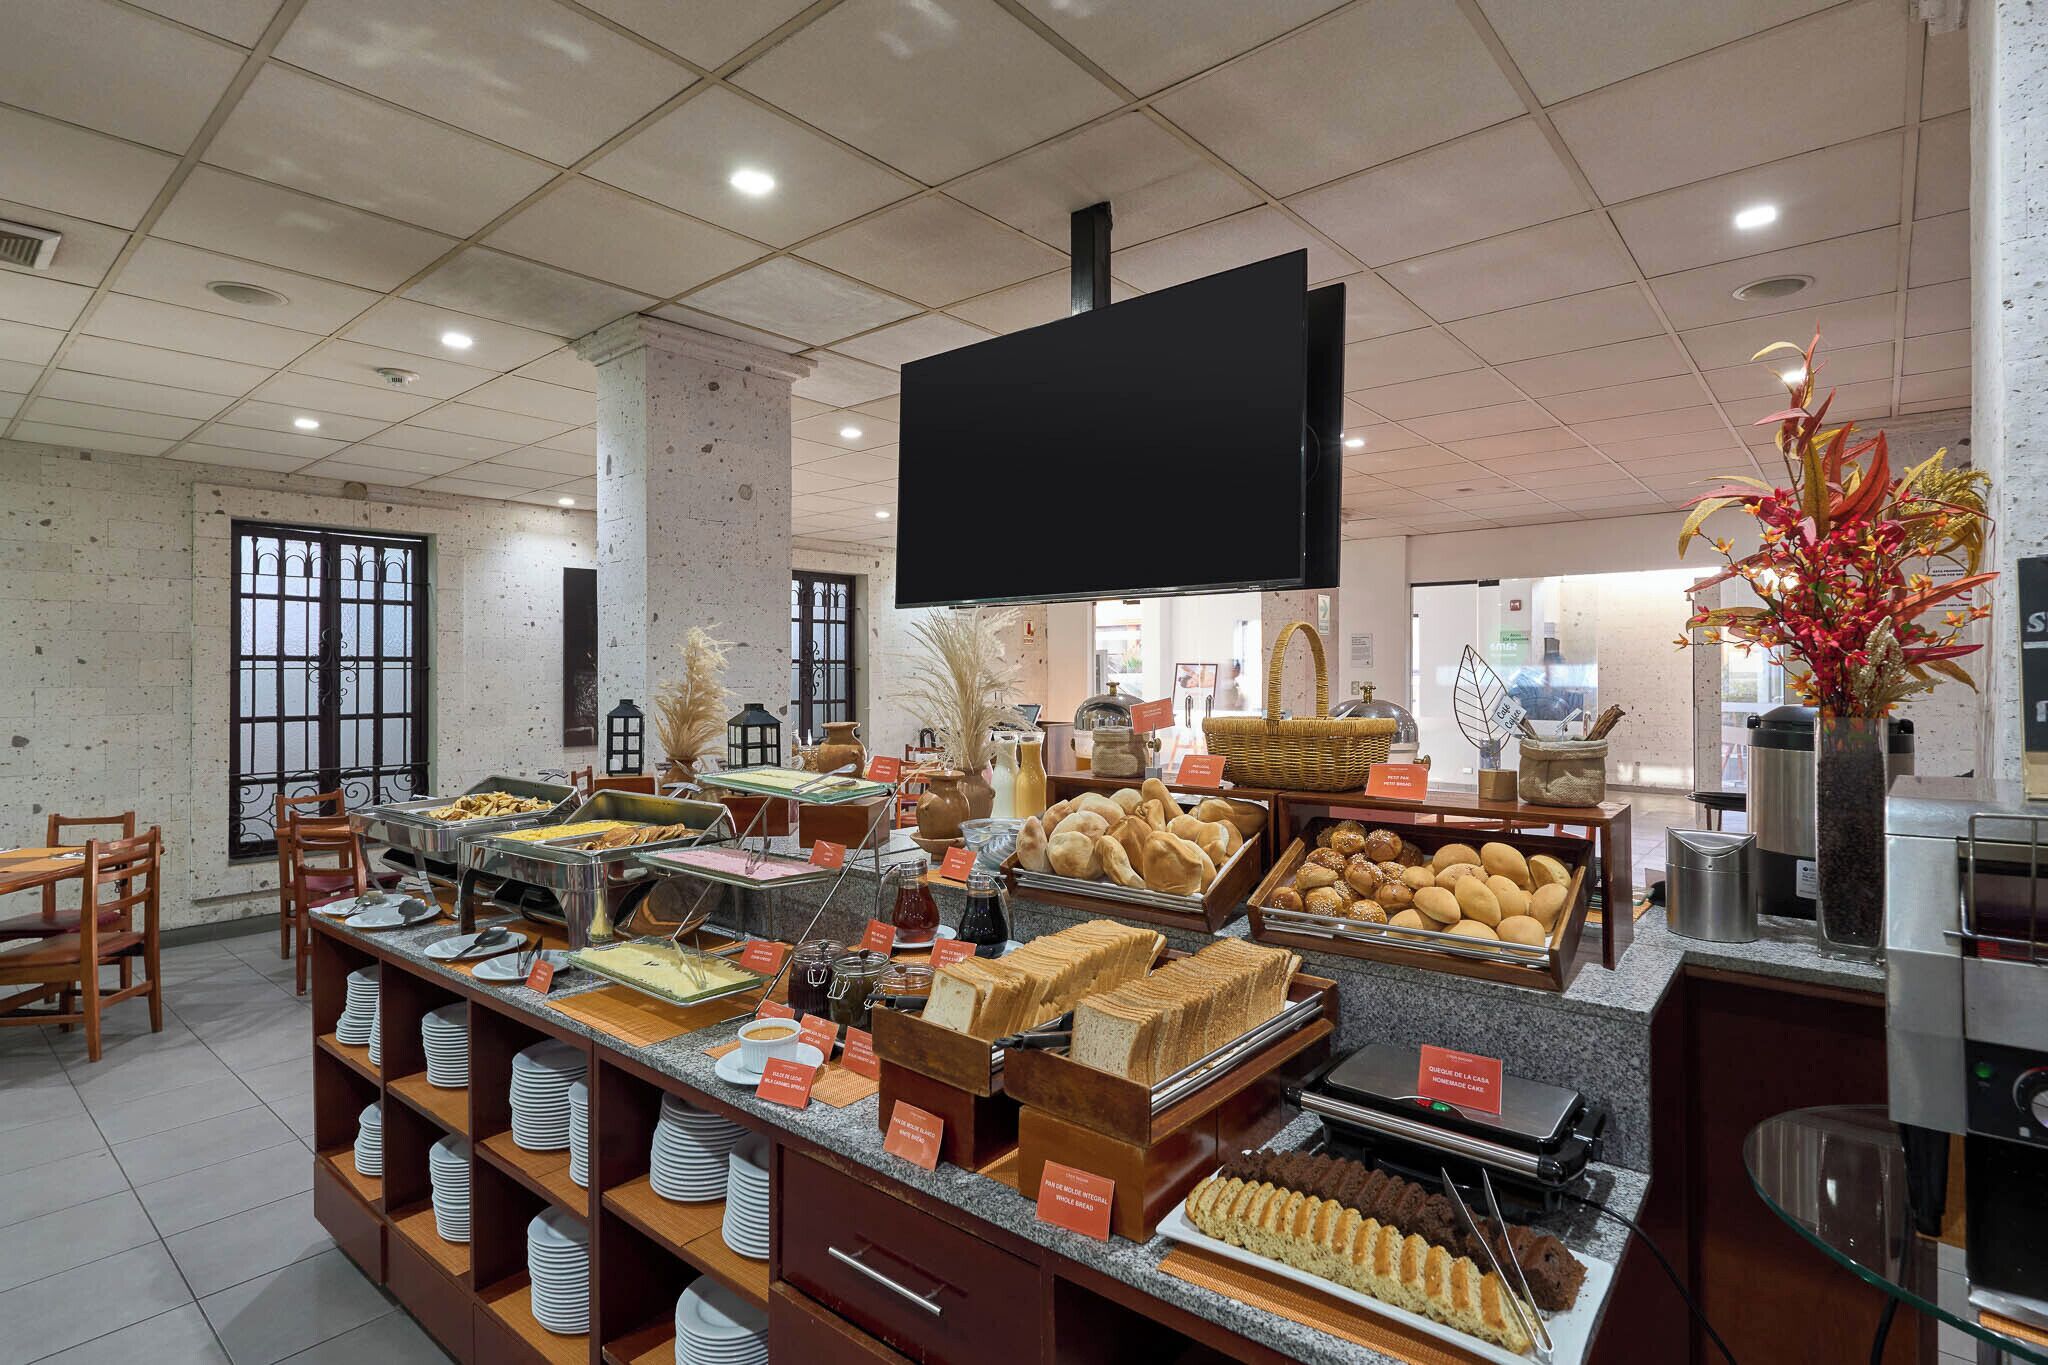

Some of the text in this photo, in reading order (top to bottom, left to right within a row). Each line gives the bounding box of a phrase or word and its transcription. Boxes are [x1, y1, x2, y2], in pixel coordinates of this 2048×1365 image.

[1497, 703, 1511, 720] Café
[1504, 709, 1522, 729] Coffee
[1428, 1065, 1453, 1076] QUEQUE
[1472, 1075, 1490, 1085] CASA
[1432, 1076, 1484, 1093] HOMEMADE CAKE
[1045, 1178, 1108, 1205] PAN DE MOLDE INTEGRAL
[1056, 1194, 1094, 1212] WHOLE BREAD
